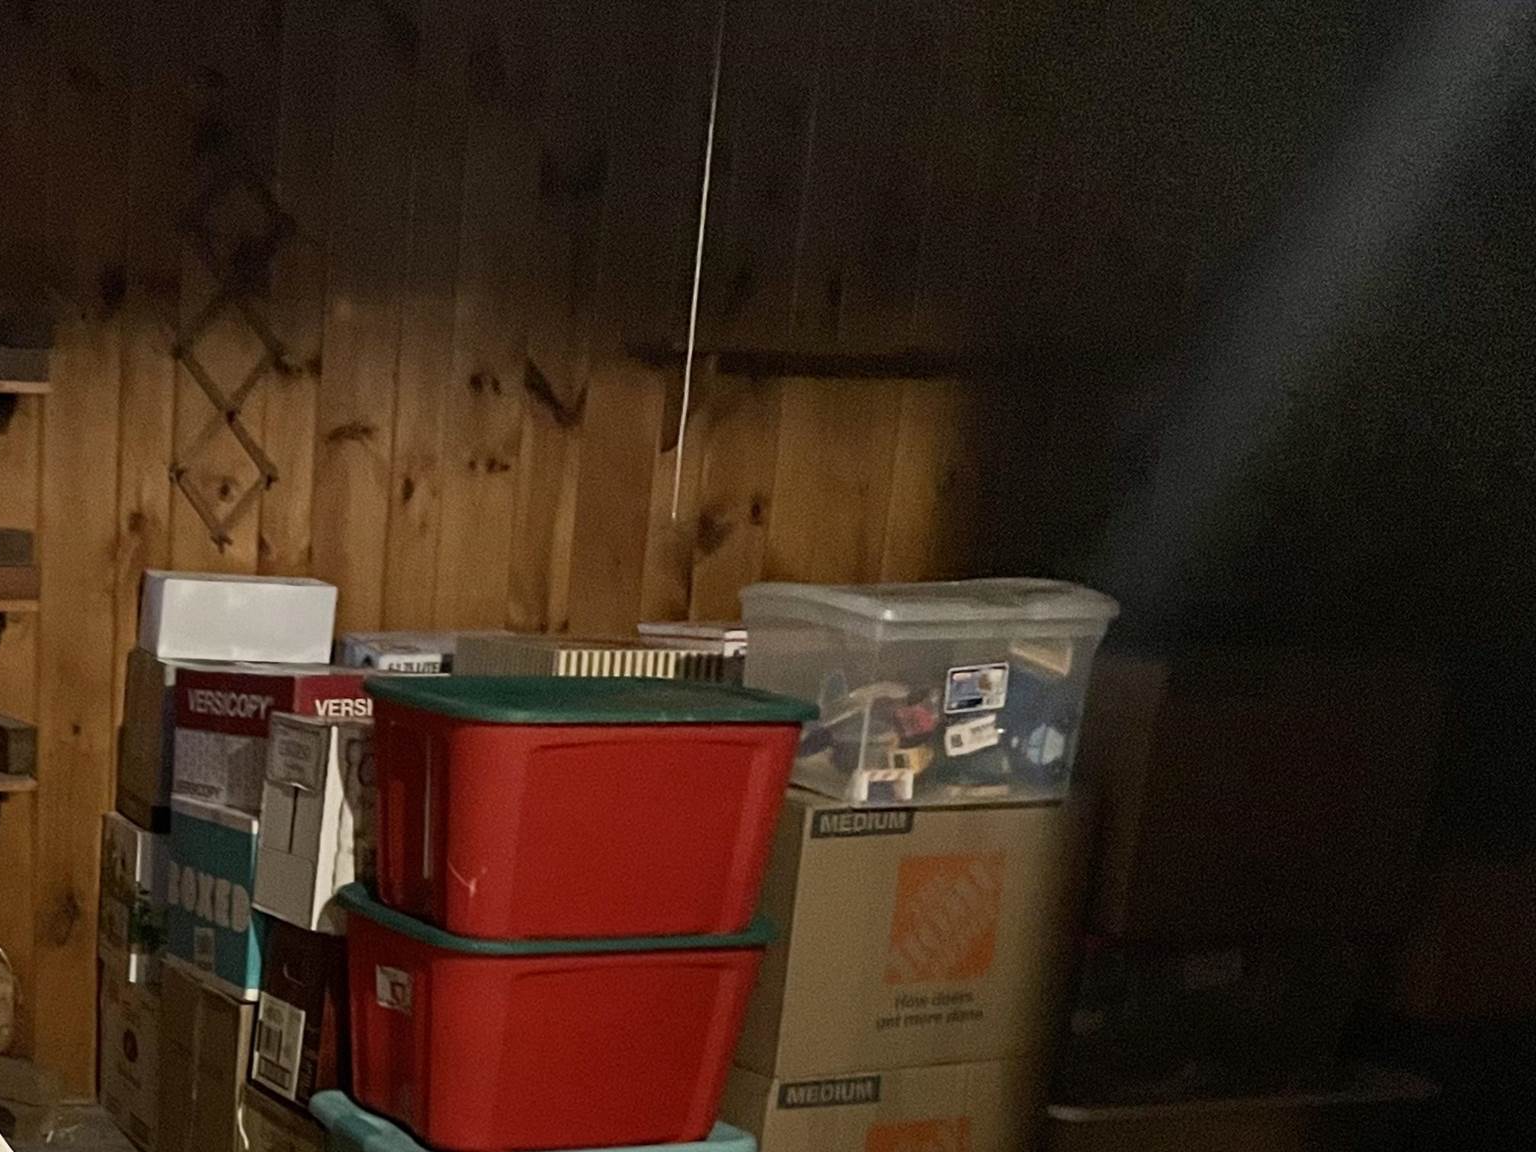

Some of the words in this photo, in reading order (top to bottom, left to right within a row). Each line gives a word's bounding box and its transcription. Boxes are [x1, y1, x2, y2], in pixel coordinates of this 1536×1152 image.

[187, 689, 270, 719] VERSICOPY
[819, 811, 907, 834] MEDIUM
[167, 860, 250, 933] BOXED
[786, 1082, 872, 1104] MEDIUM
